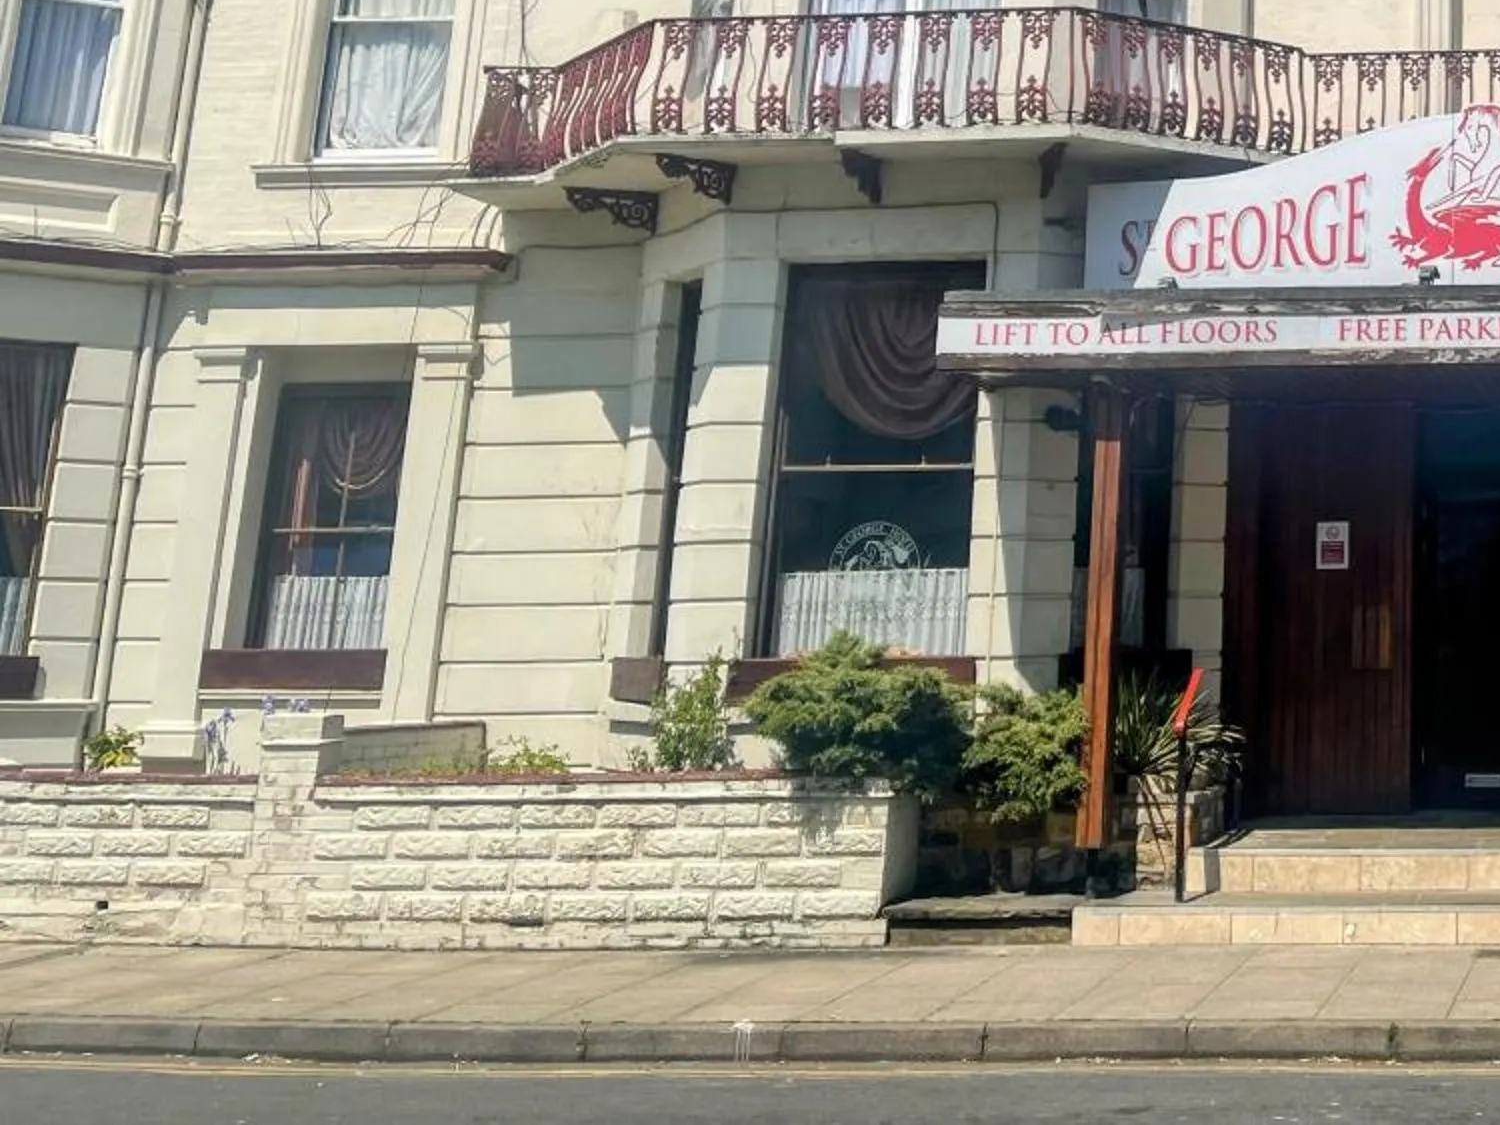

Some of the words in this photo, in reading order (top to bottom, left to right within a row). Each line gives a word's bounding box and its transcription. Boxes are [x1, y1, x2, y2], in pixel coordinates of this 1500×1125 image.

[1165, 172, 1368, 275] GEORGE
[975, 322, 1040, 346] LIFT
[1047, 320, 1090, 346] TO
[1098, 321, 1150, 345] ALL
[1160, 319, 1278, 344] FLOORS
[1338, 317, 1407, 342] FREE
